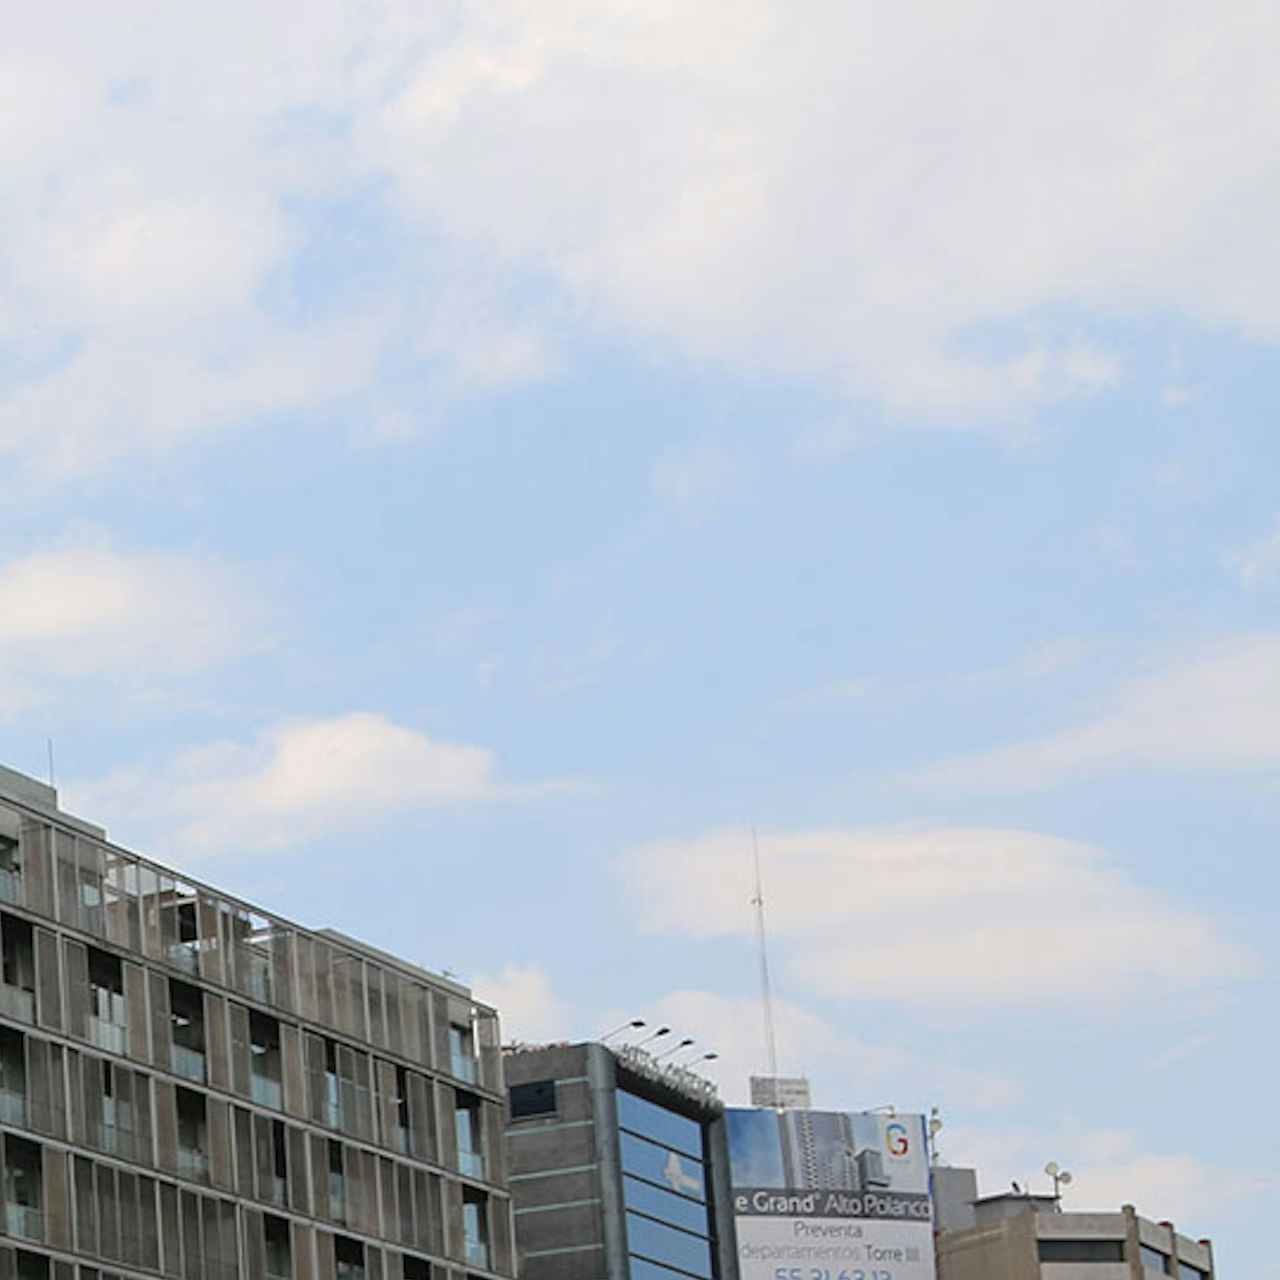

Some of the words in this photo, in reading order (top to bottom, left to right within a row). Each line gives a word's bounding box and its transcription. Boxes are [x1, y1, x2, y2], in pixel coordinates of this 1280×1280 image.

[824, 1194, 861, 1214] Alto
[864, 1194, 931, 1217] Polanco
[794, 1221, 863, 1238] Preventa
[864, 1245, 902, 1262] Torre
